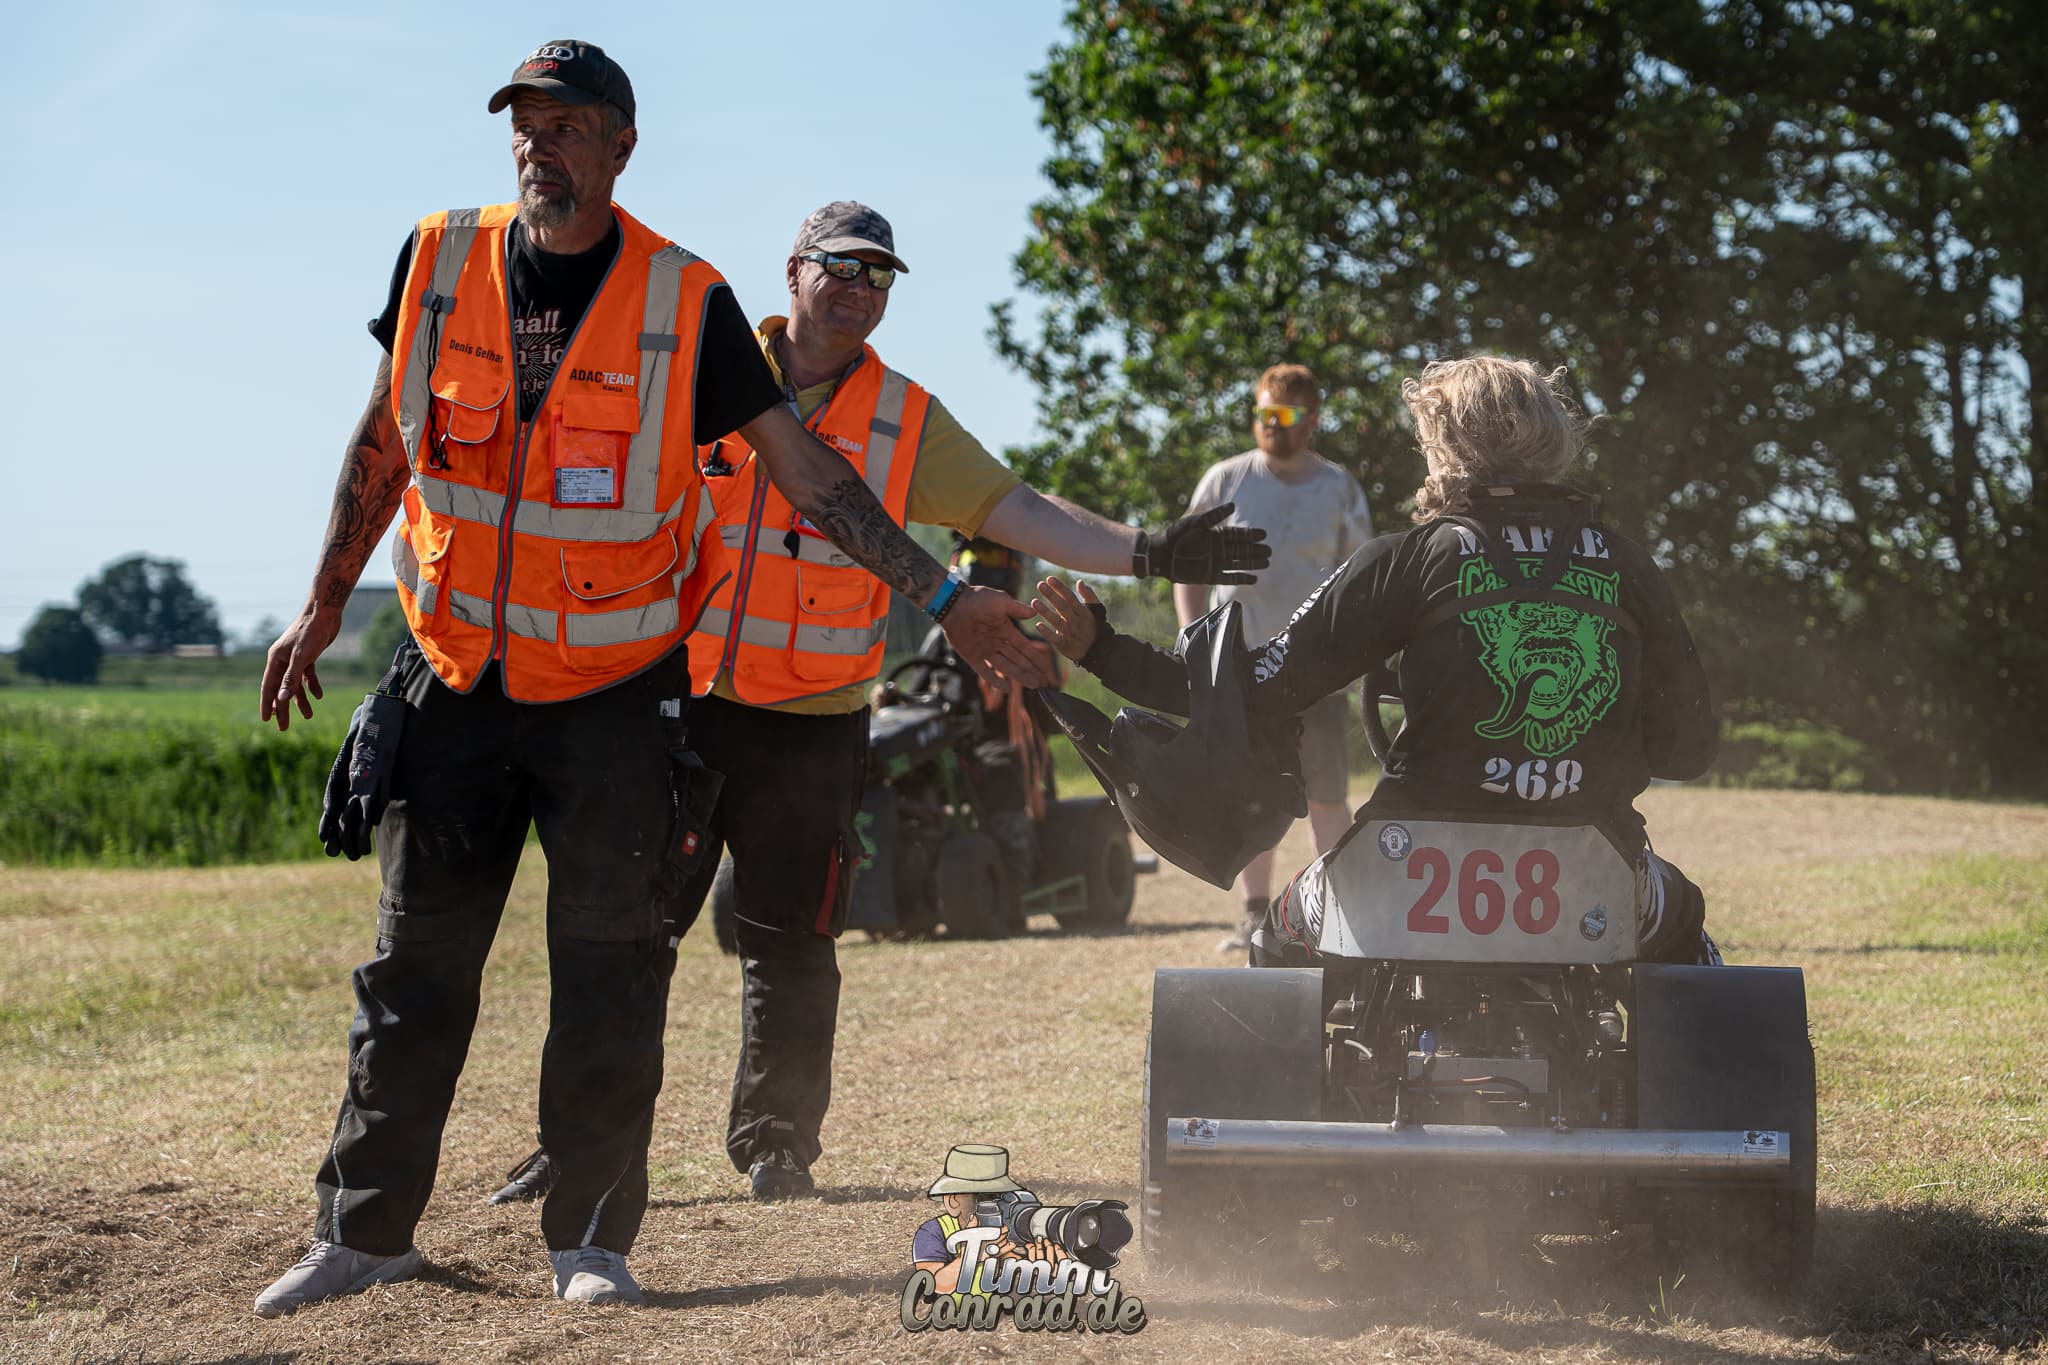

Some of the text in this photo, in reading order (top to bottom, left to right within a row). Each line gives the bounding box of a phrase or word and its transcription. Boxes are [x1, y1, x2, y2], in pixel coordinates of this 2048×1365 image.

[449, 338, 474, 355] Denis
[1479, 756, 1584, 801] 268
[1406, 845, 1561, 937] 268
